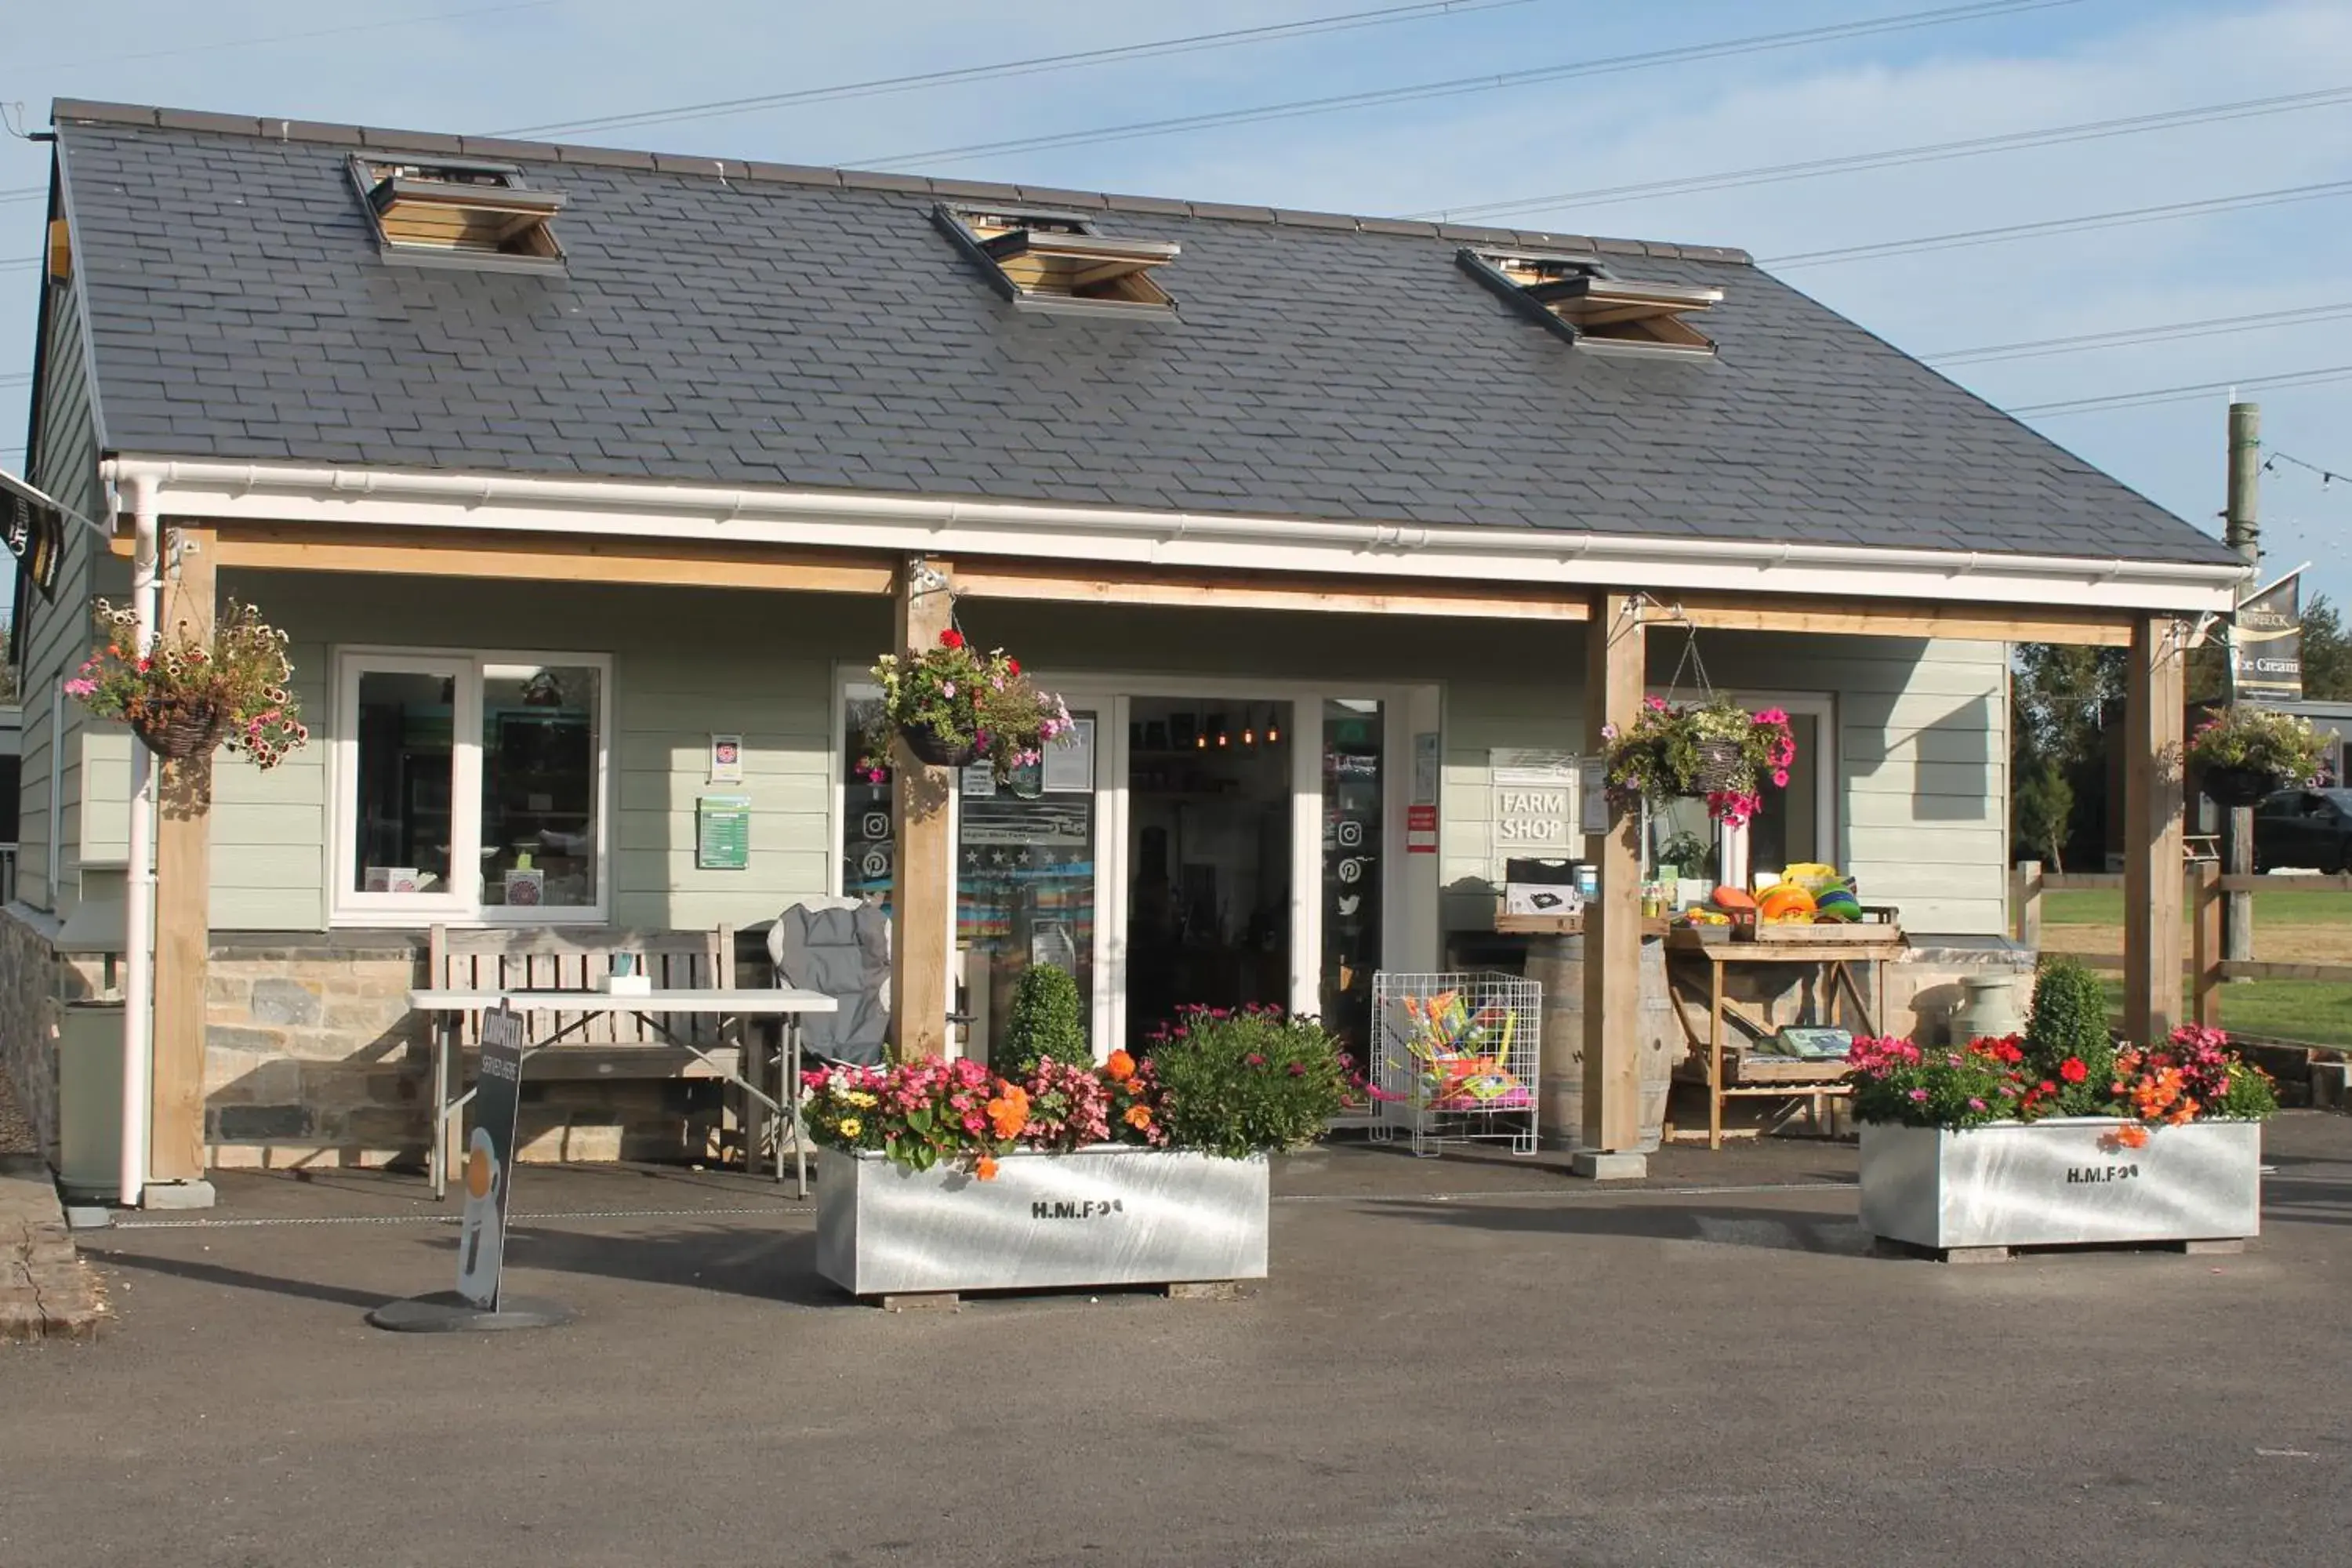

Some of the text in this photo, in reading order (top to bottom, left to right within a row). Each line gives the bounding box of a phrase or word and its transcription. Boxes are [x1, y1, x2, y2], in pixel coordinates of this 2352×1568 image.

[2257, 658, 2298, 673] Cream
[1501, 791, 1564, 812] FARM
[1501, 818, 1563, 840] SHOP
